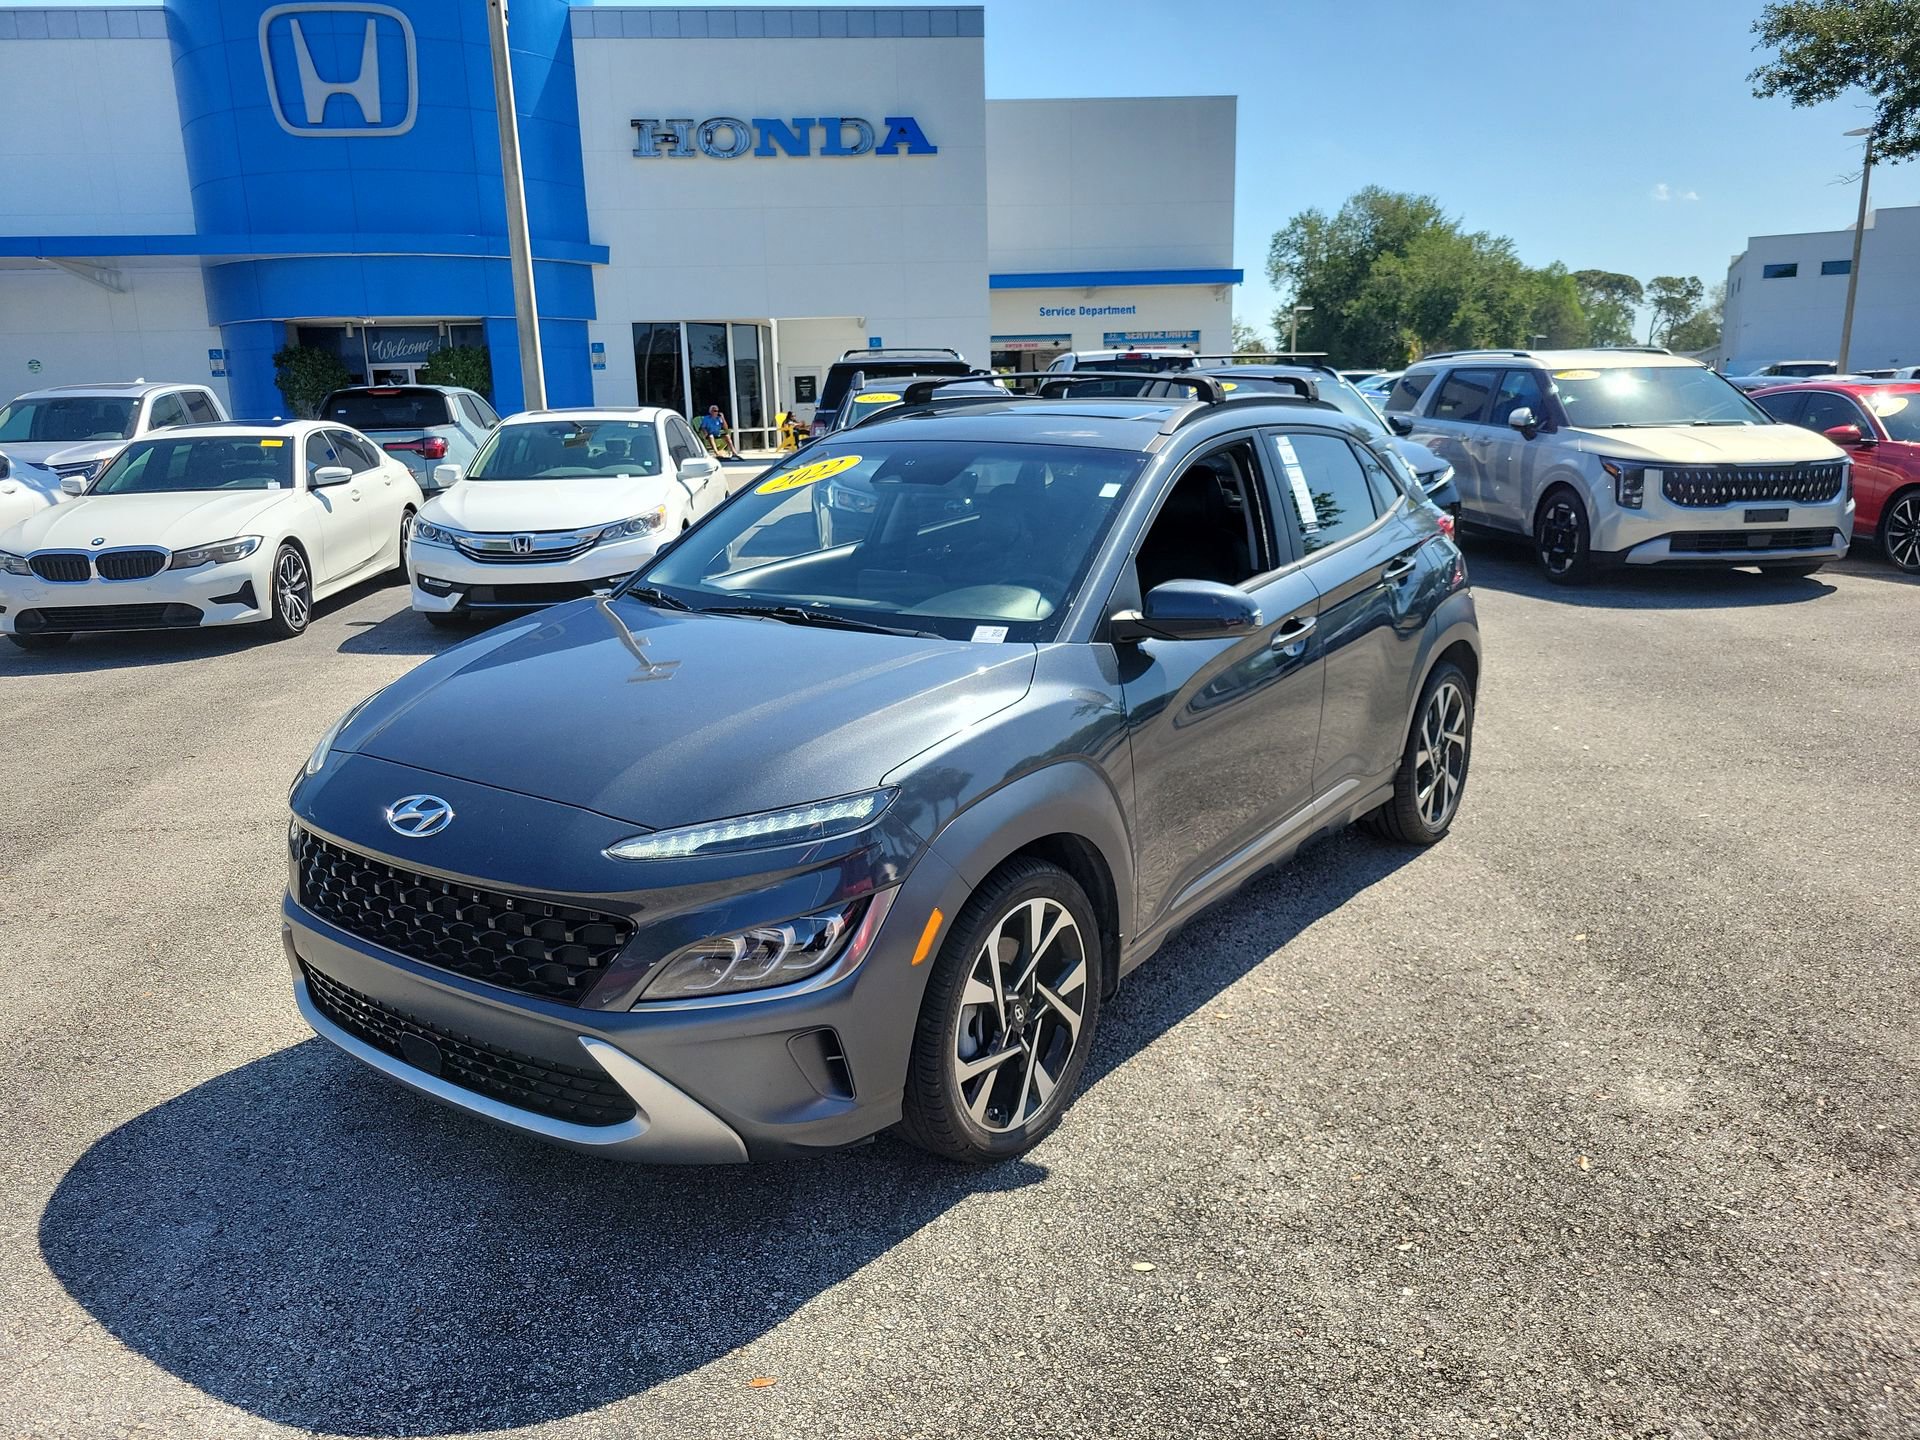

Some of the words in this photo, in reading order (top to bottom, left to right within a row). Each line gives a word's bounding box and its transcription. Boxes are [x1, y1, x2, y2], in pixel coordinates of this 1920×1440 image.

[630, 116, 938, 161] HONDA
[1040, 307, 1076, 317] Service
[1079, 305, 1136, 317] Department
[1125, 331, 1166, 340] SERVICE
[769, 459, 846, 491] 2022
